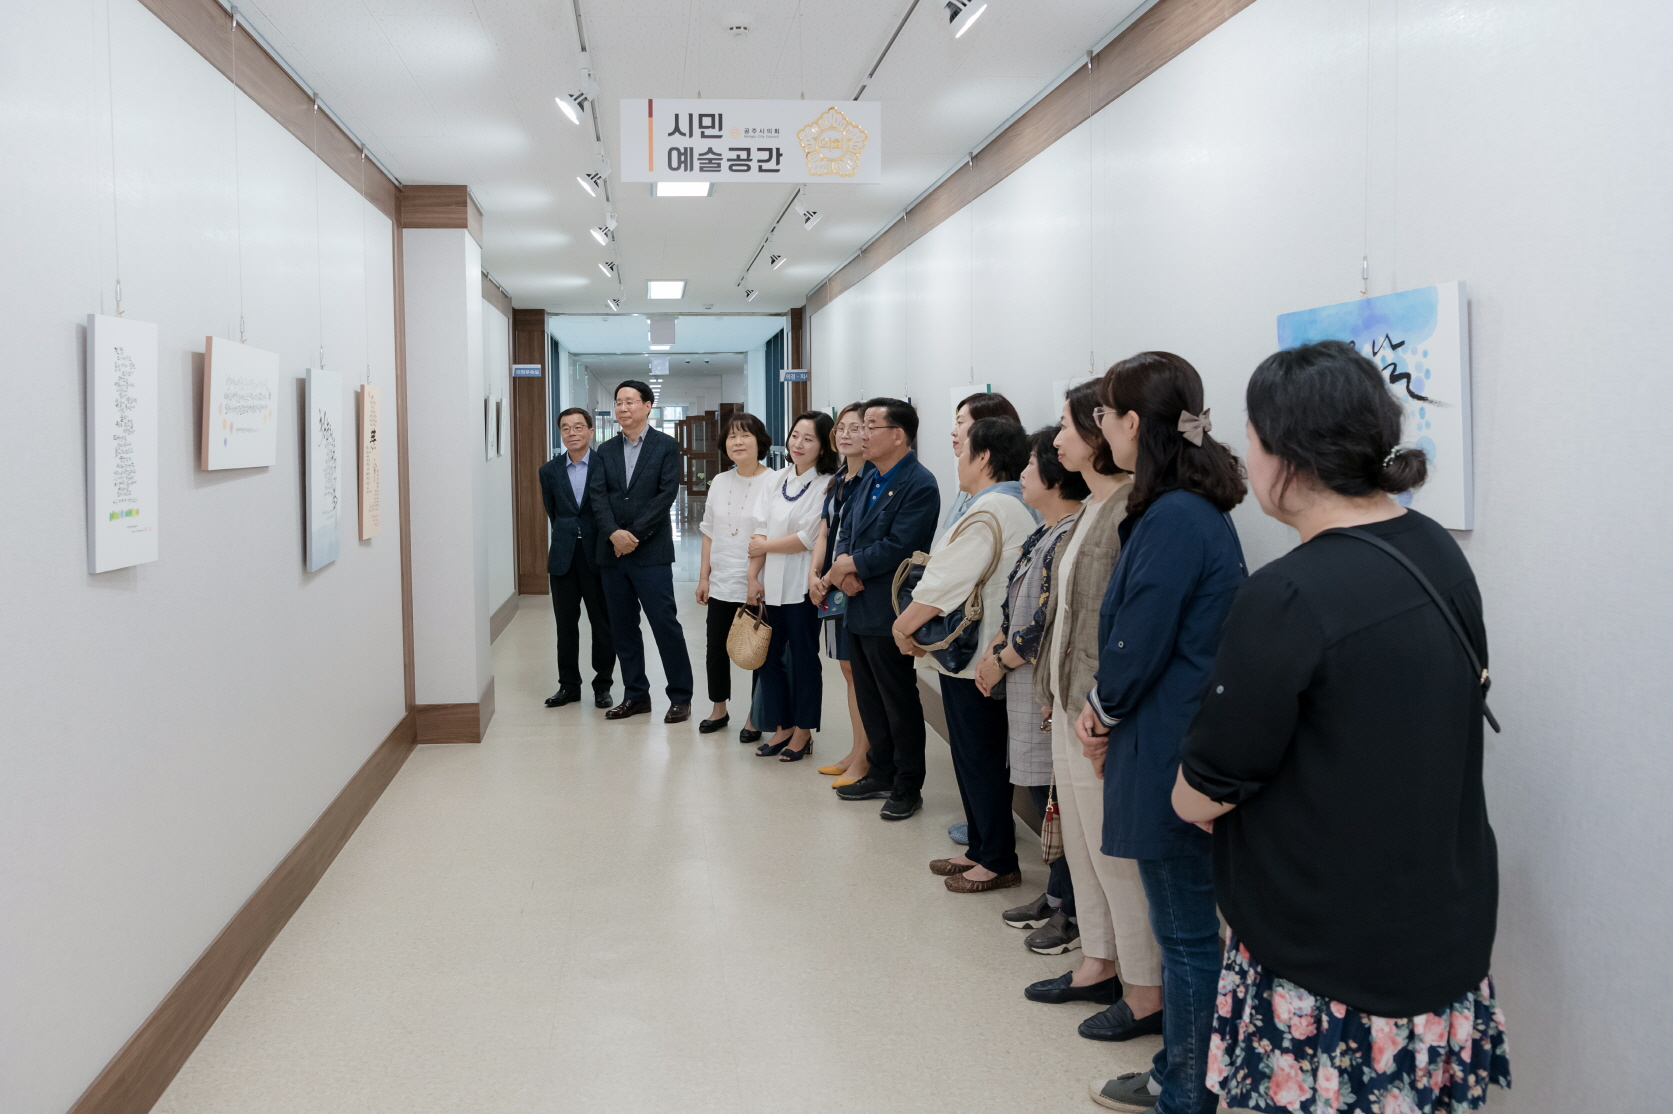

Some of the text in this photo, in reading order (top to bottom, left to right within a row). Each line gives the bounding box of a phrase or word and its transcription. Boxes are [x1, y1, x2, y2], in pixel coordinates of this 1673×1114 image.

[667, 112, 724, 139] 시민
[743, 127, 780, 135] 공주시의회
[667, 146, 784, 173] 예술공간
